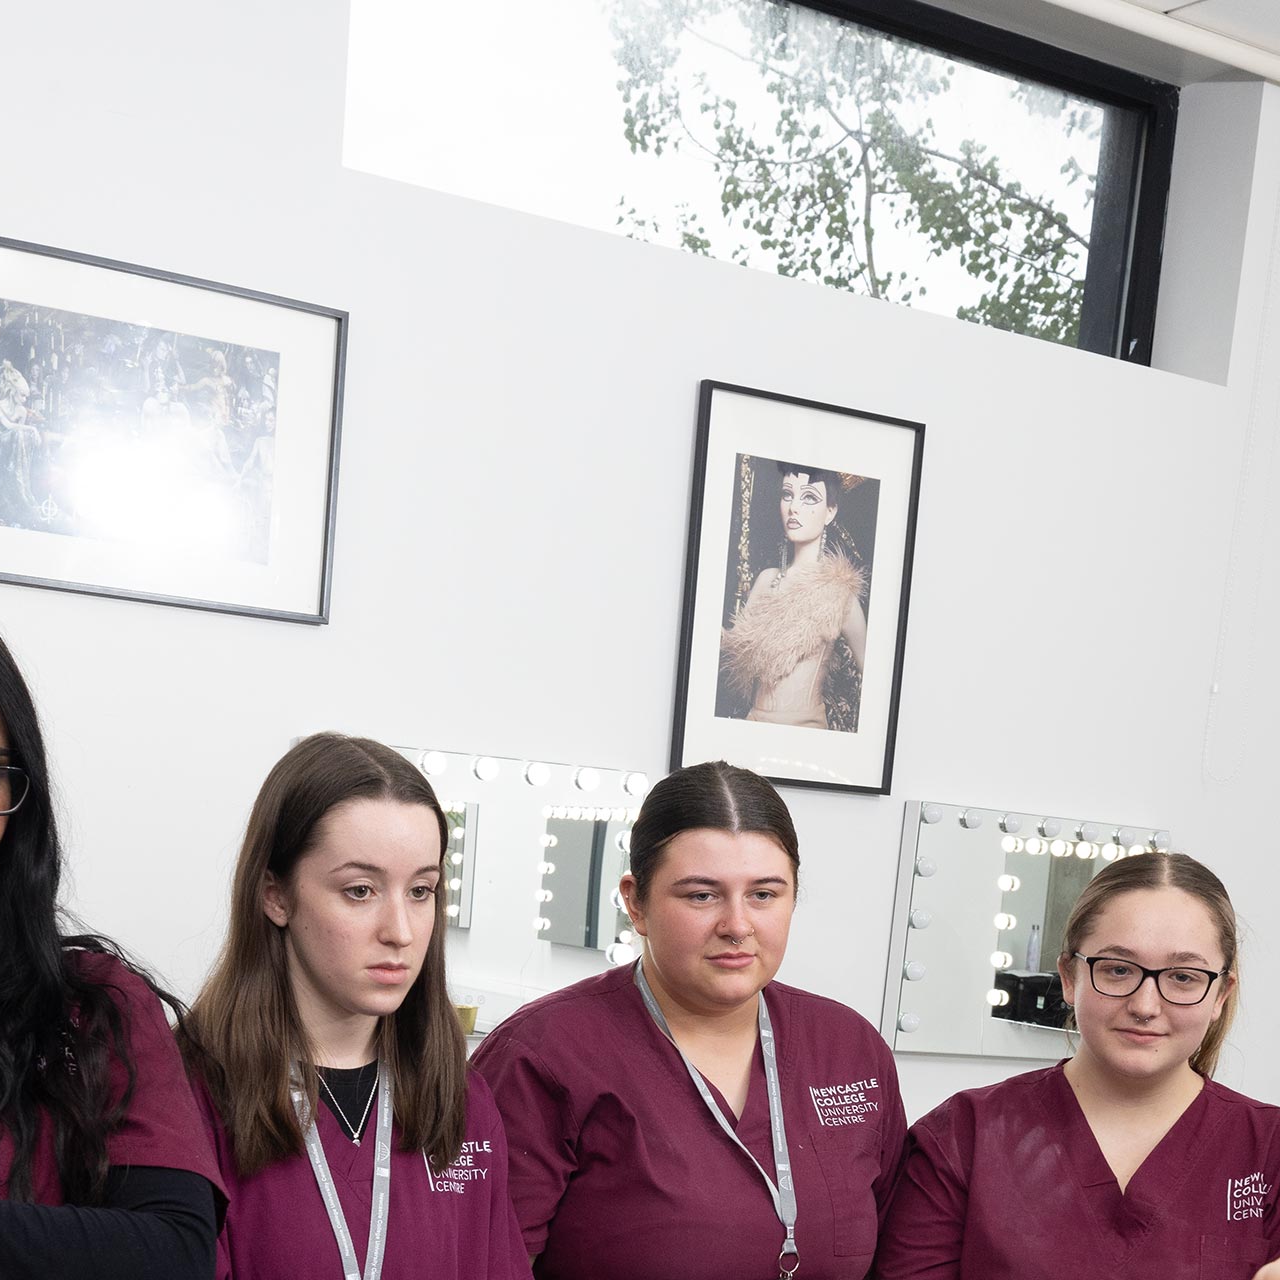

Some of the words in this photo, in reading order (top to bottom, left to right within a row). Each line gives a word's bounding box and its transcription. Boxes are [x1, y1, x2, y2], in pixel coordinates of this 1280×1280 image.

[813, 1078, 879, 1097] NEWCASTLE
[816, 1092, 867, 1107] COLLEGE
[820, 1101, 879, 1117] UNIVERSITY
[824, 1114, 866, 1127] CENTRE
[1233, 1183, 1272, 1198] COLL
[331, 1208, 342, 1229] College
[1233, 1208, 1264, 1221] CENT
